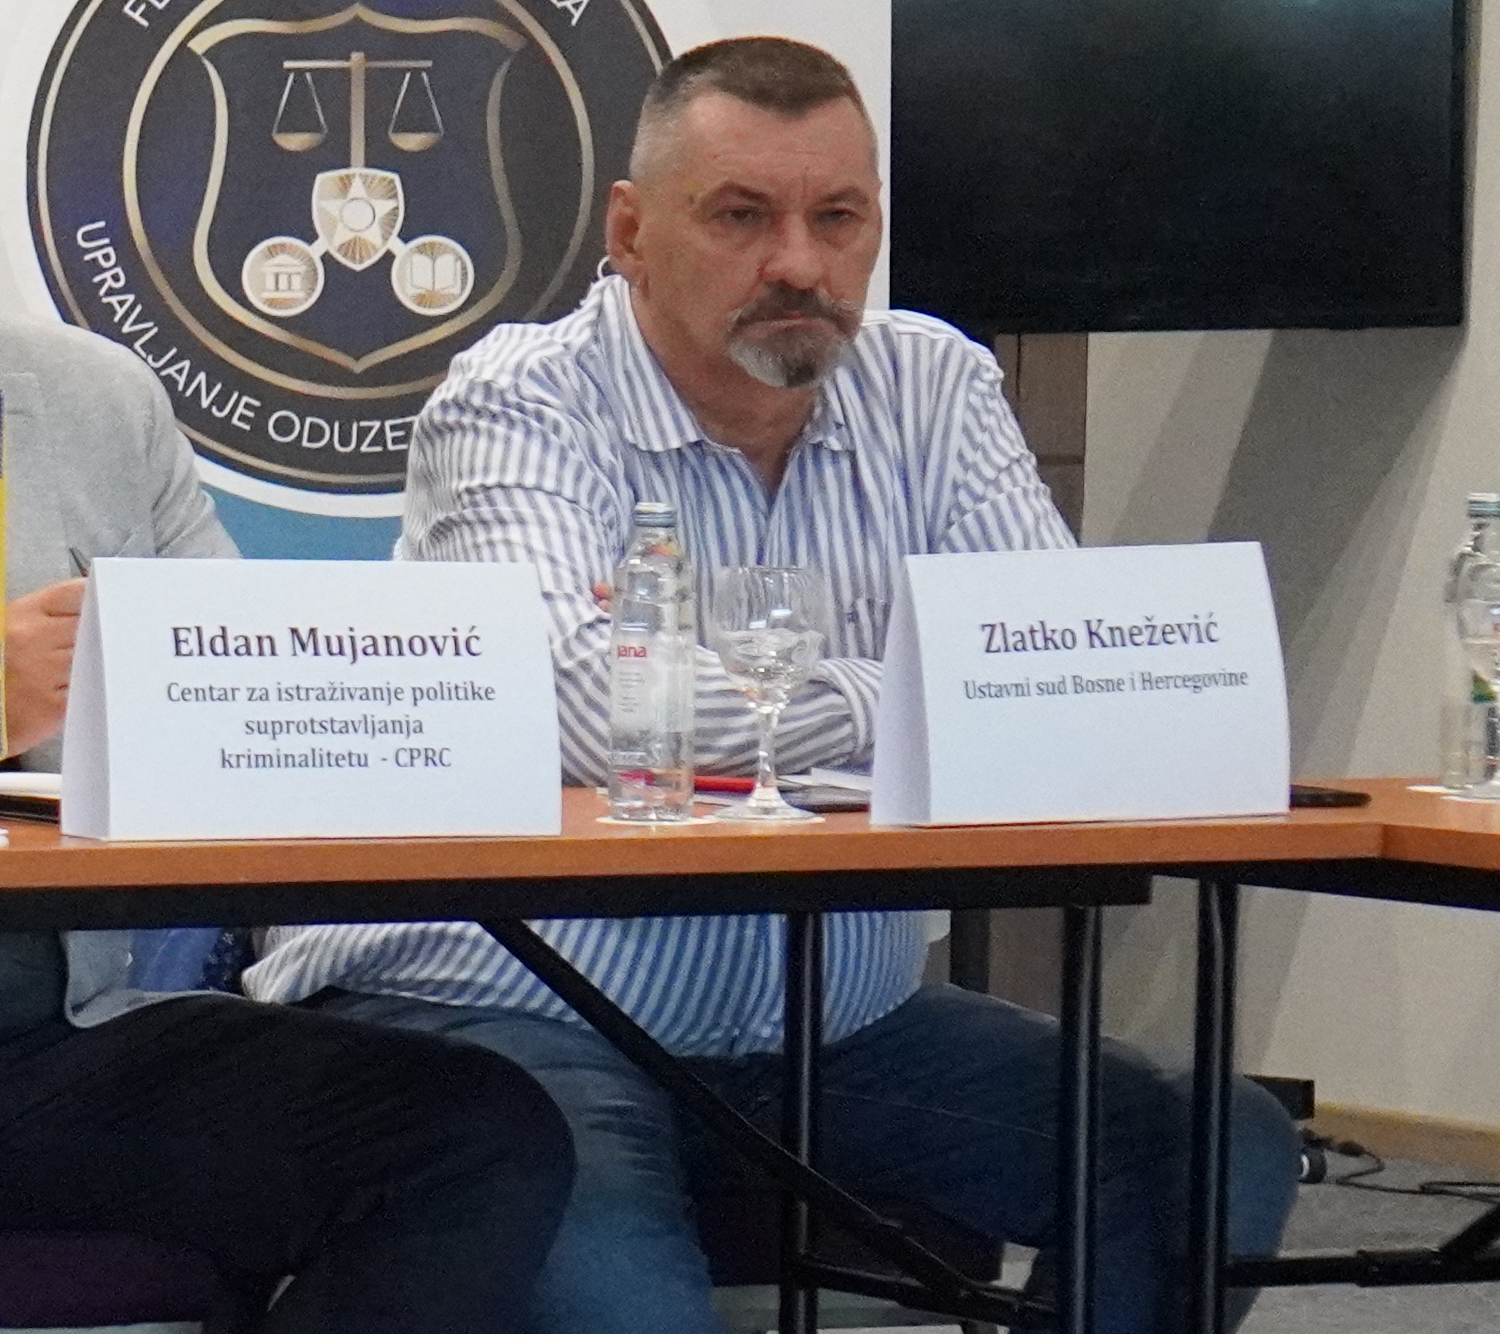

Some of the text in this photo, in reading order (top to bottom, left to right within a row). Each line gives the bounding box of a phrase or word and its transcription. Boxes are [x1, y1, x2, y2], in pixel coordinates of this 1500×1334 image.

[77, 221, 415, 452] UPRAVLJANJE ODUZE
[171, 625, 481, 665] Eldan Mujanović
[980, 612, 1219, 654] Zlatko Knežević
[166, 680, 496, 707] Centar za istraživanje politike
[963, 677, 1032, 700] Ustavni
[1035, 675, 1068, 697] sud
[1071, 674, 1126, 695] Bosne
[1139, 668, 1249, 694] Hercegovine
[244, 713, 424, 741] suprotstavljanja
[220, 747, 369, 769] kriminalitetu
[394, 747, 451, 768] CPRC
